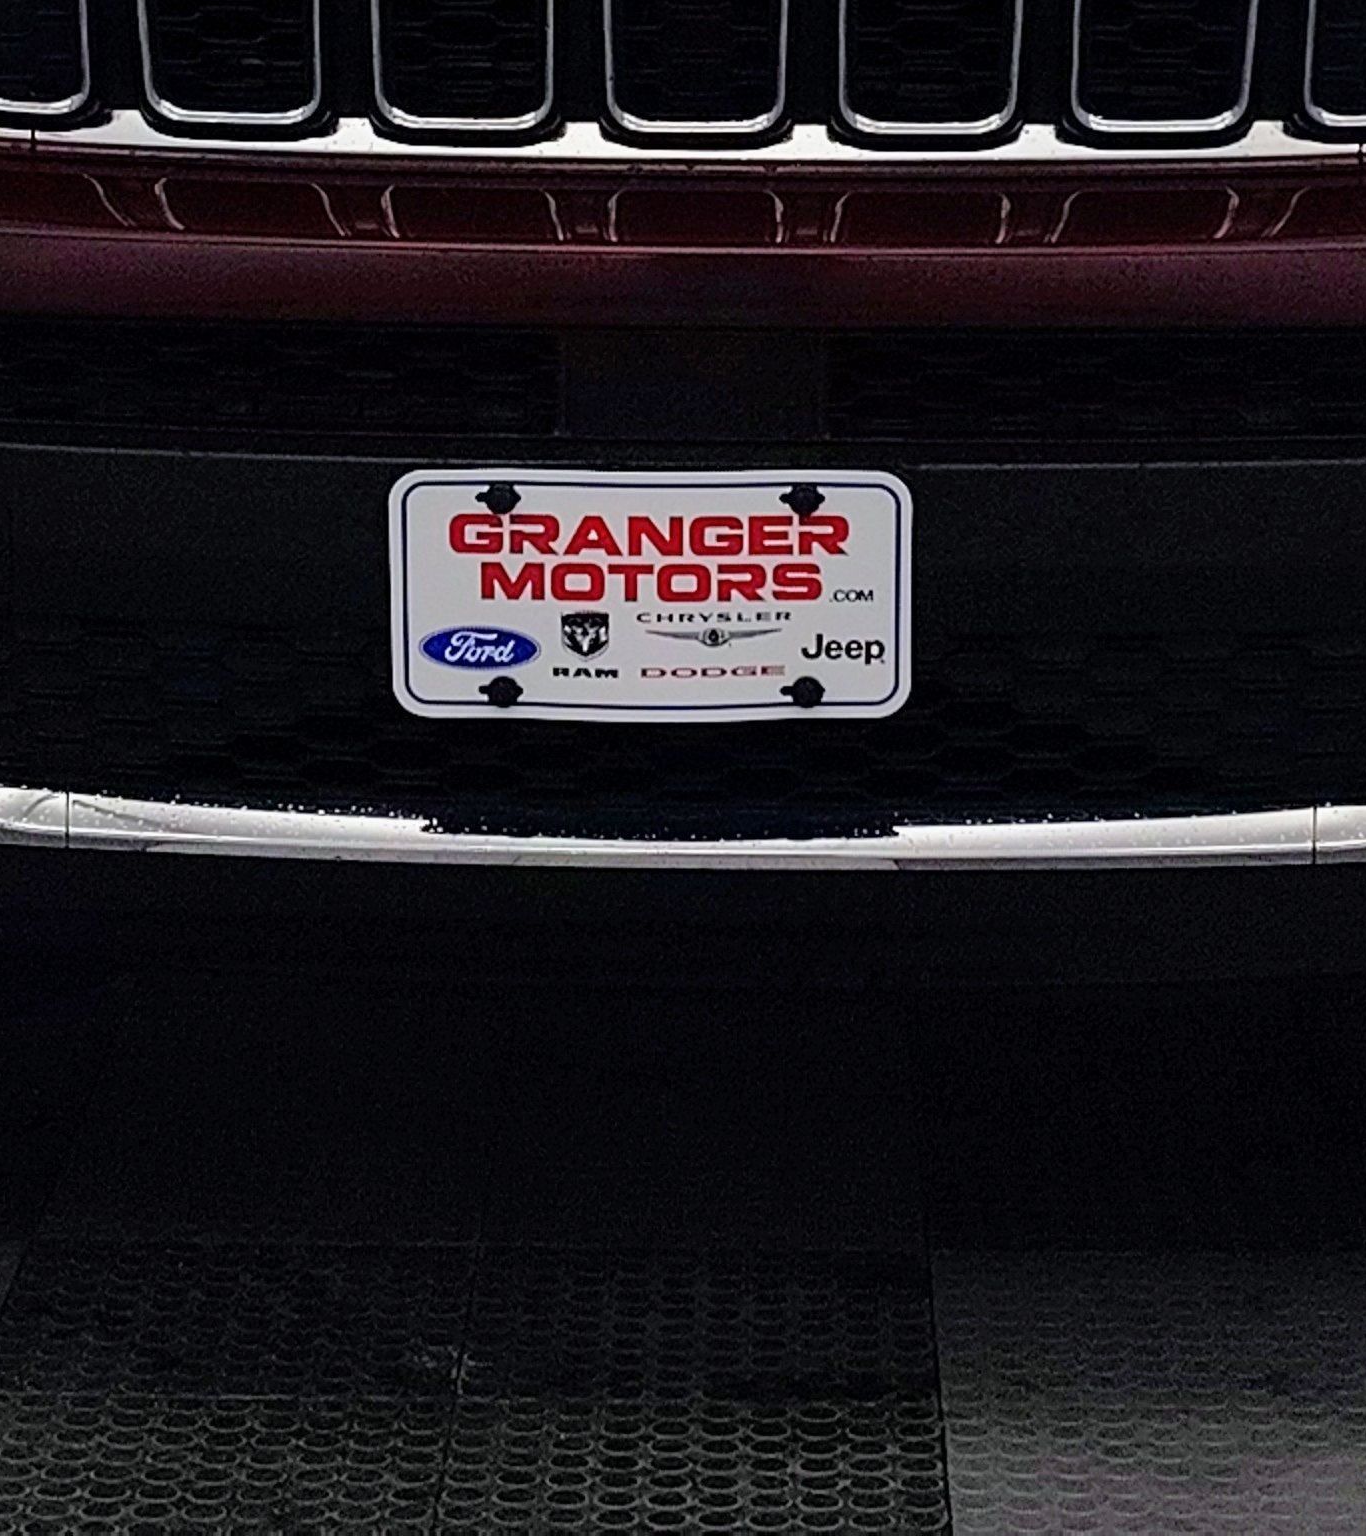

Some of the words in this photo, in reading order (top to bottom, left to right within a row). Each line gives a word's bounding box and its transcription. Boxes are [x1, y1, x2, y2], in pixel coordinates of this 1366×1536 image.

[448, 513, 850, 557] GRANGER
[480, 561, 823, 603] MOTORS
[829, 589, 874, 603] .COM
[636, 611, 792, 624] CHRYSLER
[444, 630, 516, 663] Ford
[801, 633, 886, 665] Jeep
[552, 667, 619, 679] RAM
[640, 665, 786, 678] DODGE
